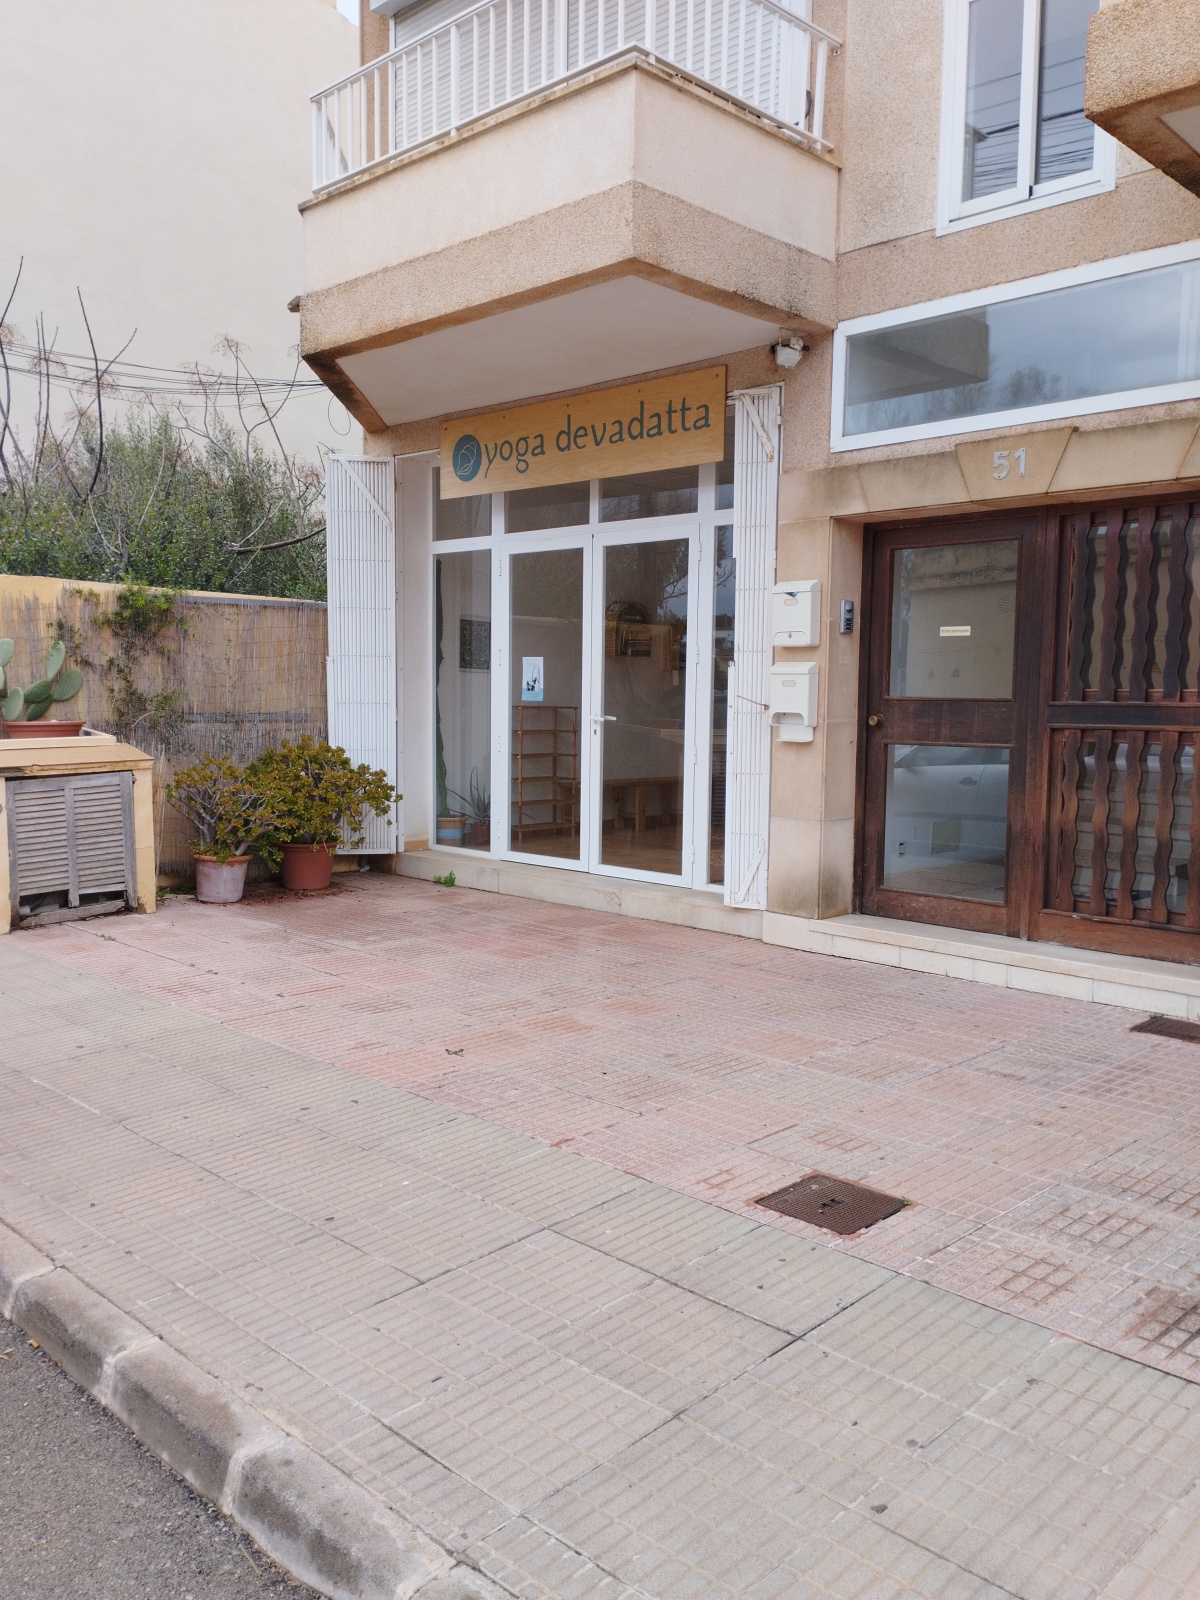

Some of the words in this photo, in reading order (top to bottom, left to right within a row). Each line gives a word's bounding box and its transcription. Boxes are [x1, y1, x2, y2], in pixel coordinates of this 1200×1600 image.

[484, 433, 546, 479] yoga
[555, 397, 712, 452] devadatta
[992, 447, 1026, 480] 51
